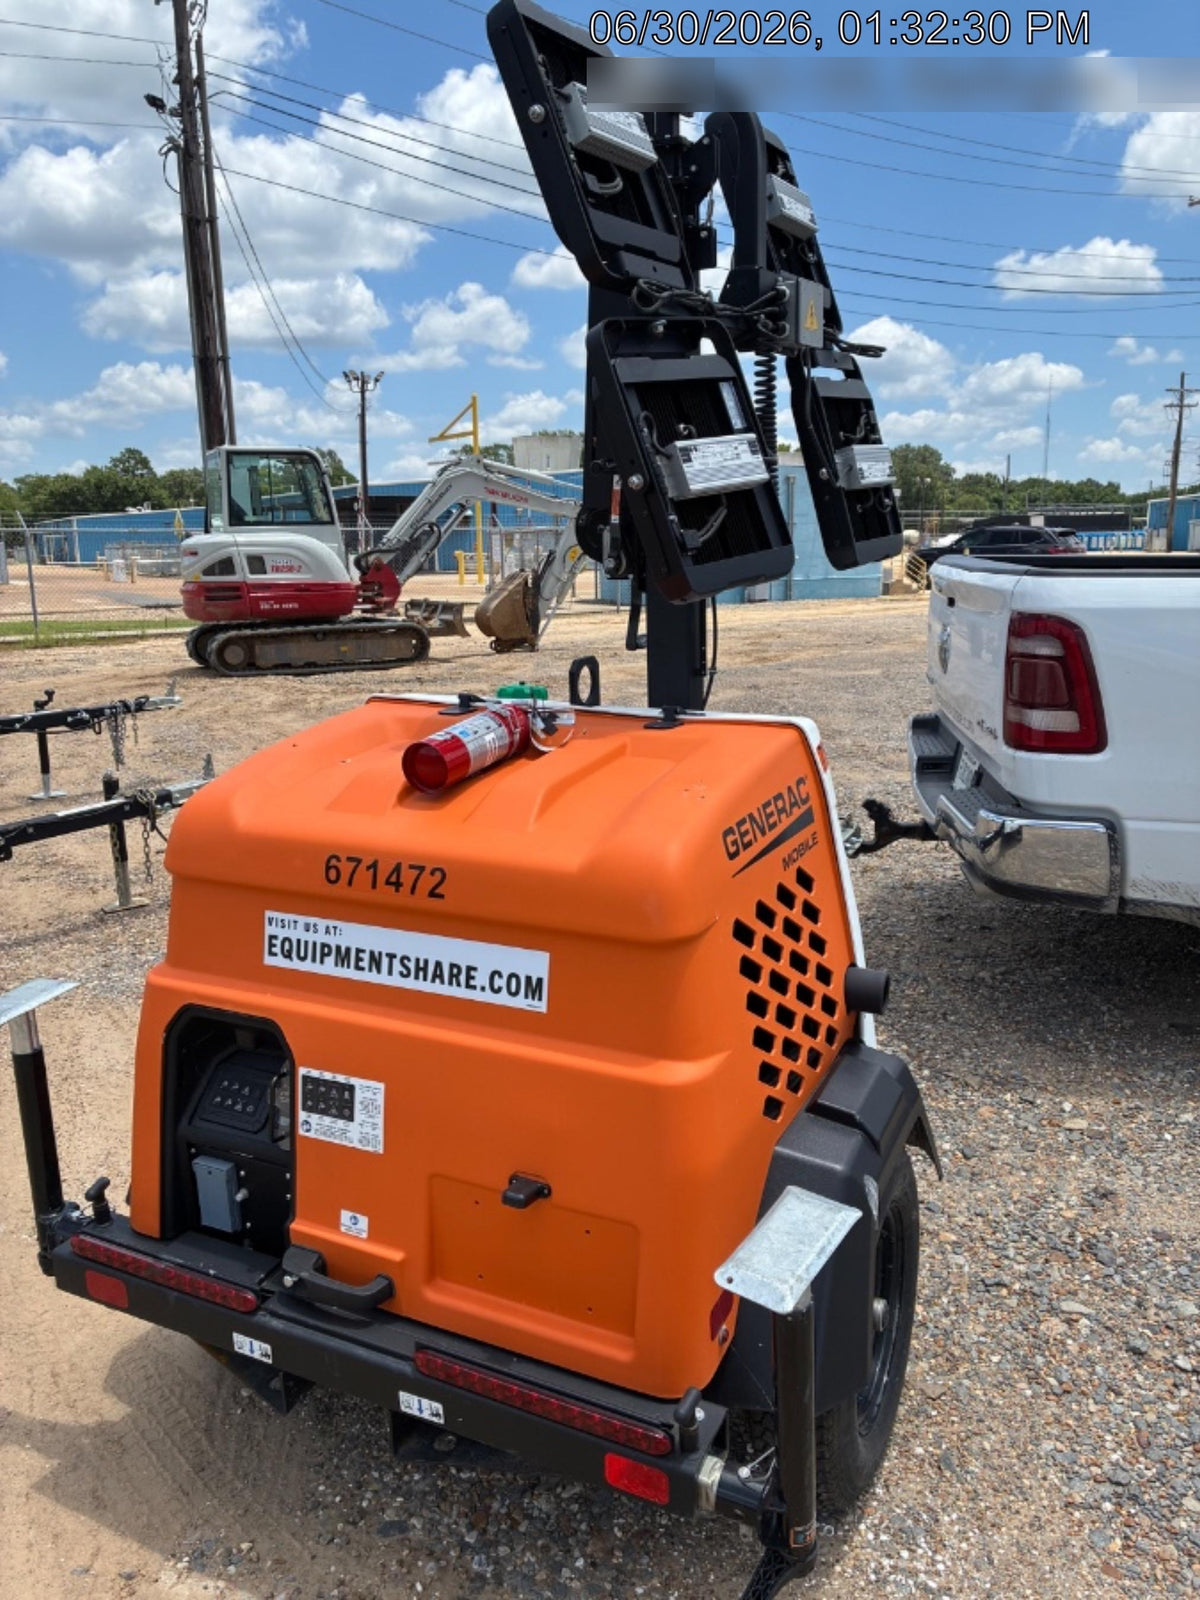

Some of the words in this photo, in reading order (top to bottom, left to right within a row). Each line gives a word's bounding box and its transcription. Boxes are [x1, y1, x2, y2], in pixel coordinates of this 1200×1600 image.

[722, 776, 810, 861] GENERAC
[782, 831, 819, 872] MOBILE
[324, 854, 447, 899] 671472
[267, 916, 299, 930] VISIT
[304, 922, 318, 934] US
[325, 925, 343, 936] AT:
[267, 934, 543, 1001] EQUIPMENTSHARE.COM
